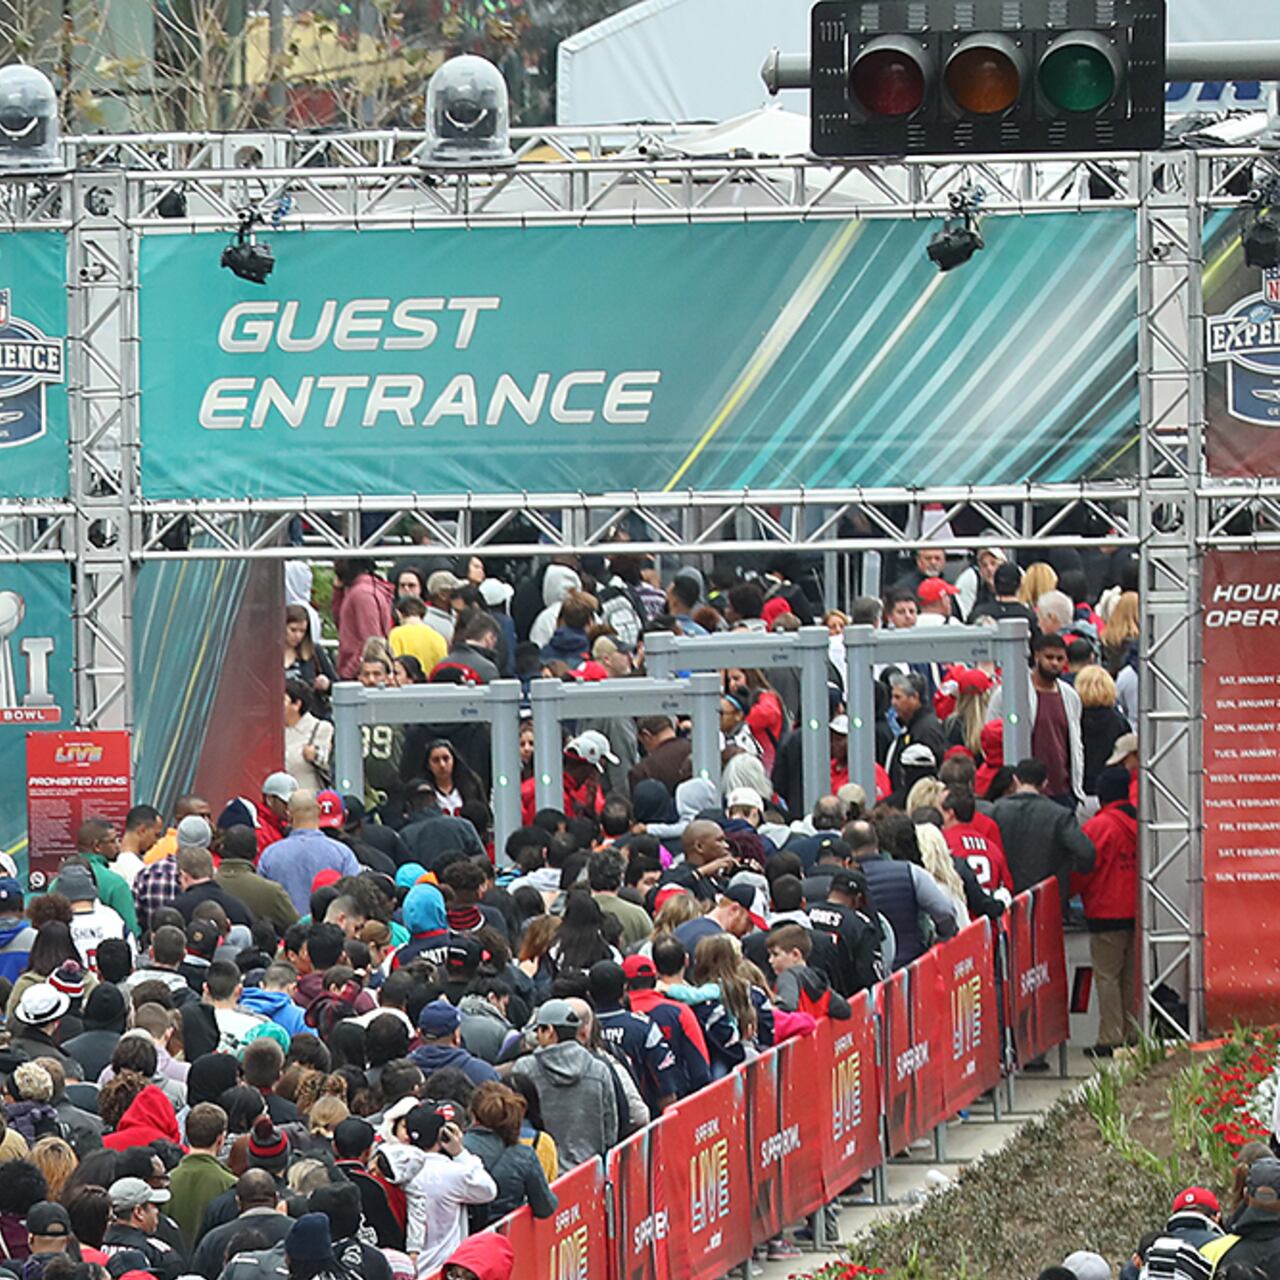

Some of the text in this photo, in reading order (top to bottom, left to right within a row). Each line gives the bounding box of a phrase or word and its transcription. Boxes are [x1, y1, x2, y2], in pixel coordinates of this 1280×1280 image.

[218, 296, 501, 353] GUEST
[199, 370, 662, 430] ENTRANCE
[1205, 608, 1280, 628] OPER
[3, 709, 44, 719] BOWL
[29, 777, 92, 786] PROHIBITED
[321, 801, 333, 813] T
